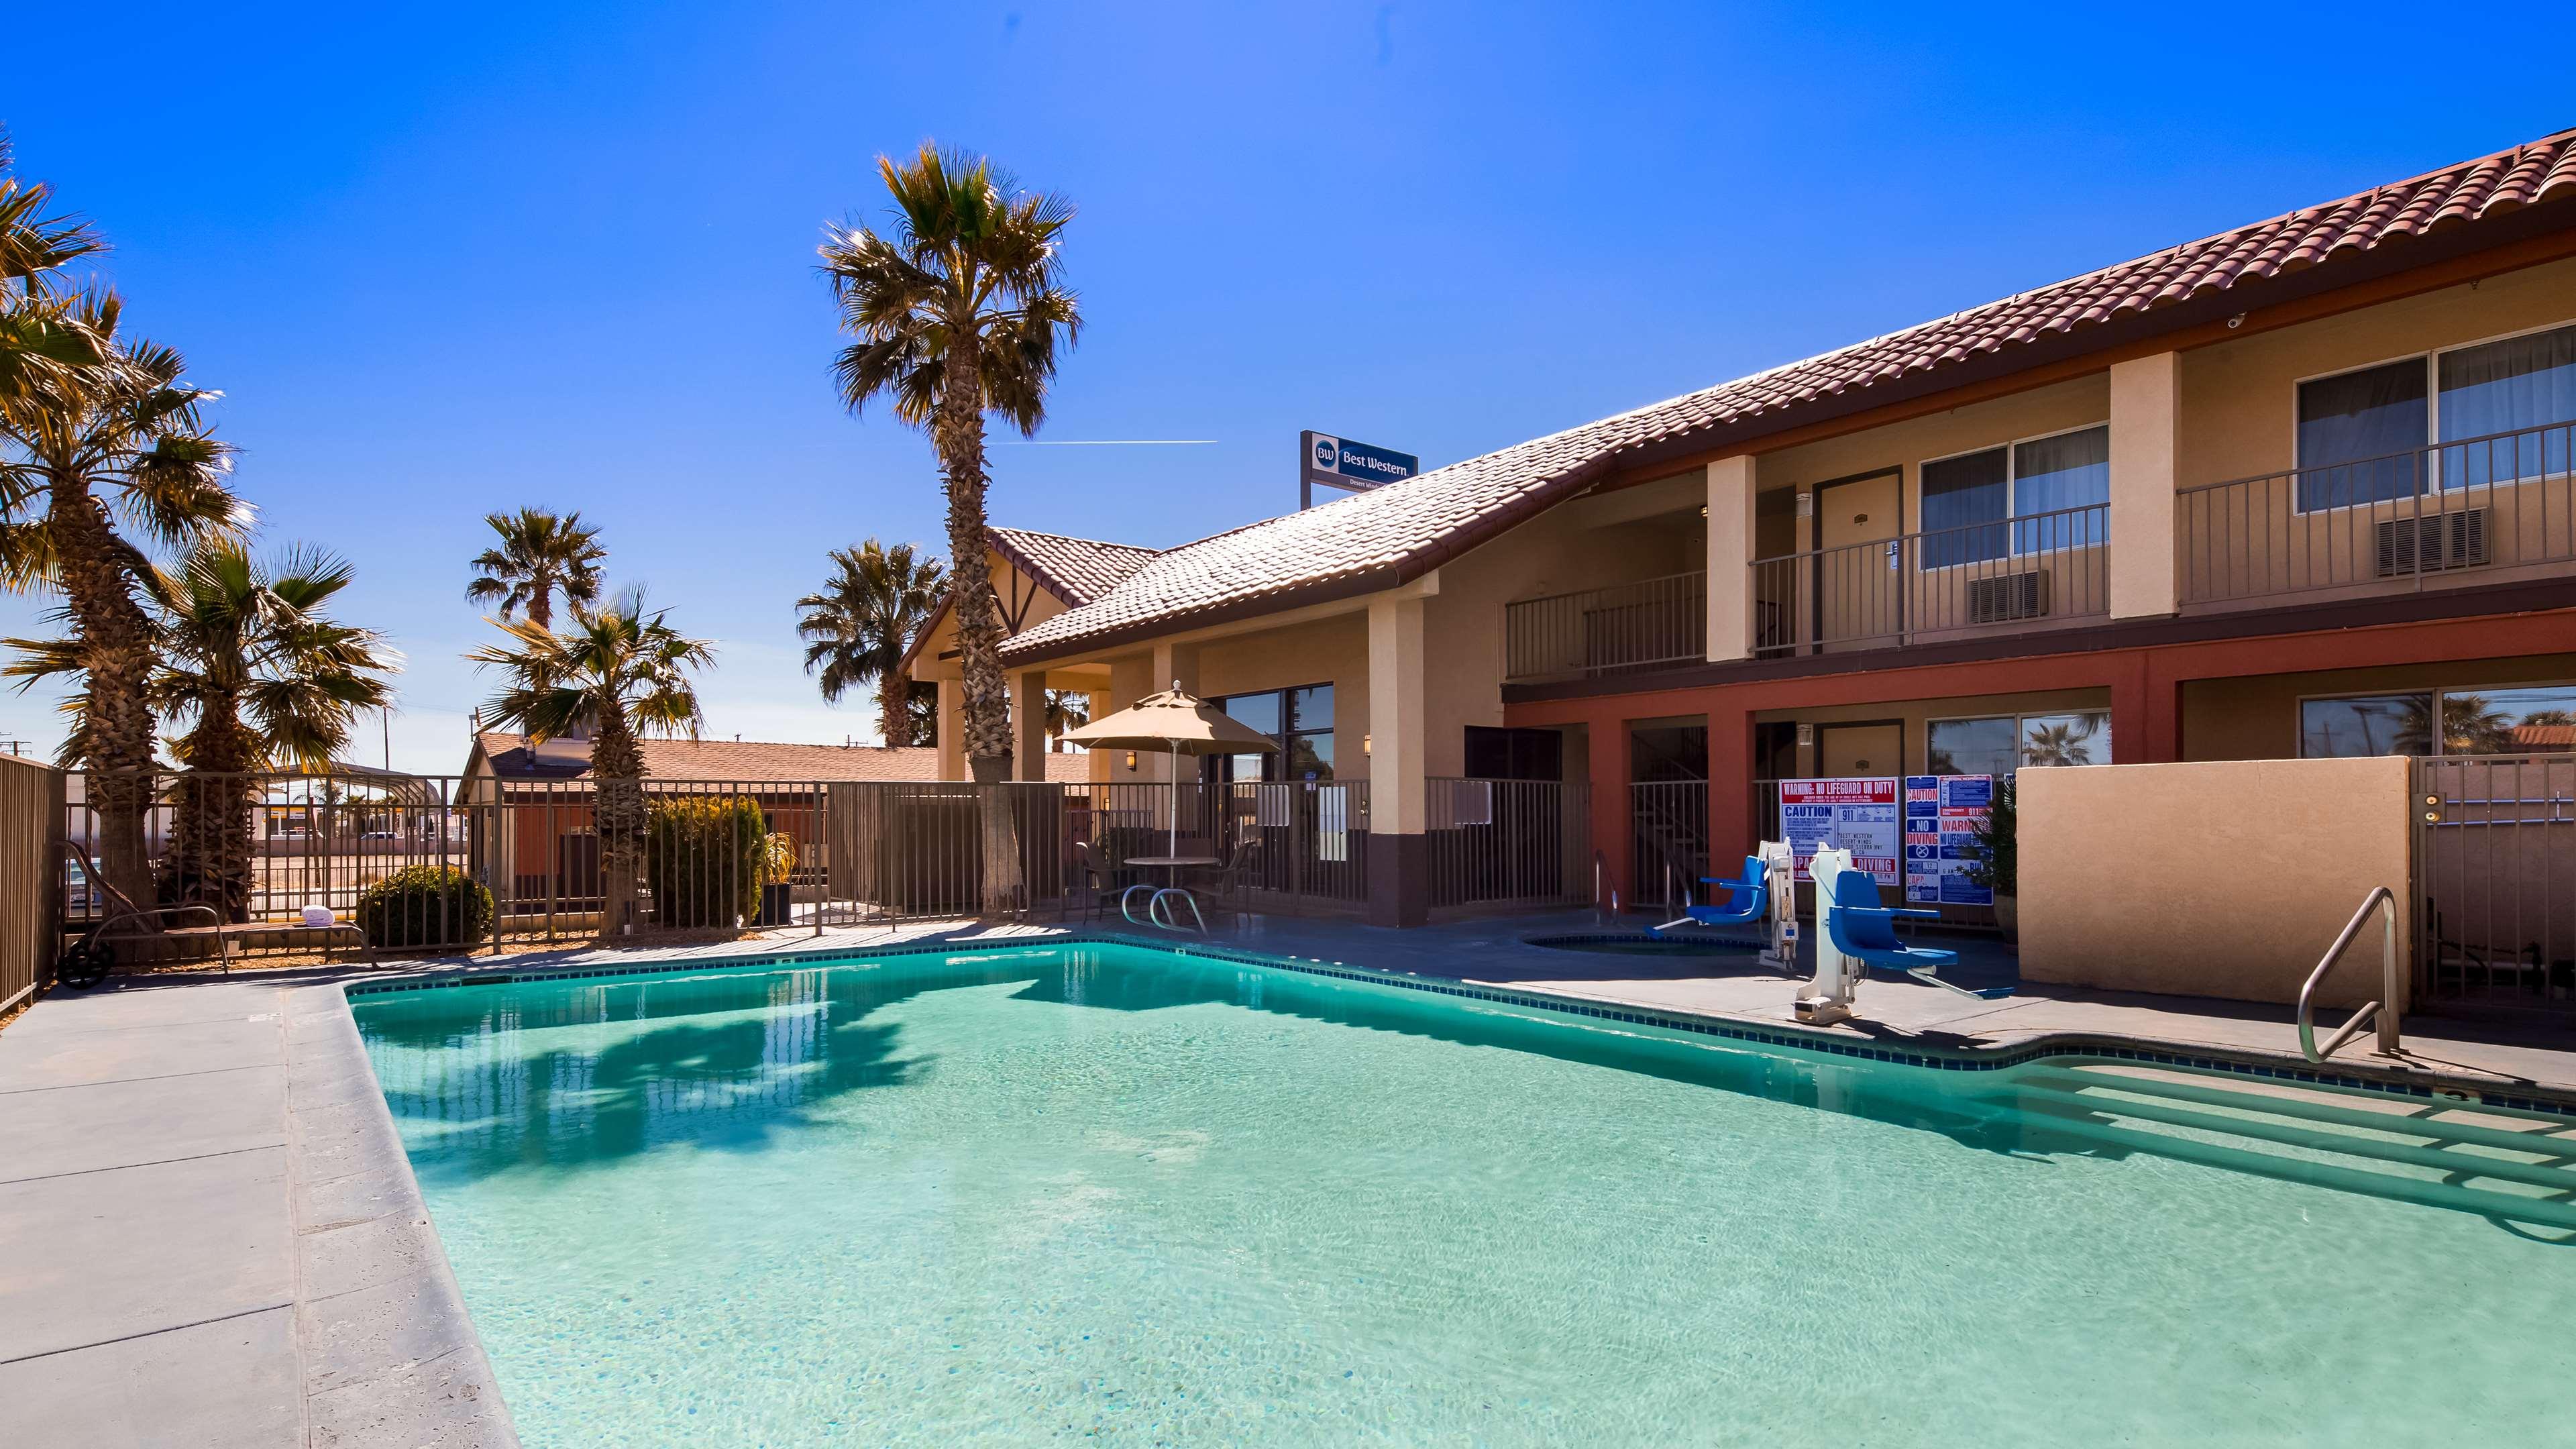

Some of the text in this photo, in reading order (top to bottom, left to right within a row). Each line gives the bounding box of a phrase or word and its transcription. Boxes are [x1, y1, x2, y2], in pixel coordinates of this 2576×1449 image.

[1318, 447, 1334, 460] BW
[1344, 451, 1407, 476] Best Western
[1350, 479, 1365, 488] Desert
[1784, 782, 1892, 795] WARNING: NO LIFEGUARD ON DUTY
[1907, 789, 1937, 801] CAUTION
[1785, 806, 1832, 817] CAUTION
[1842, 810, 1854, 821] 911
[1968, 808, 1979, 816] 911
[1917, 820, 1929, 832] NO
[1907, 834, 1938, 845] DIVING
[1858, 859, 1892, 871] DIVING
